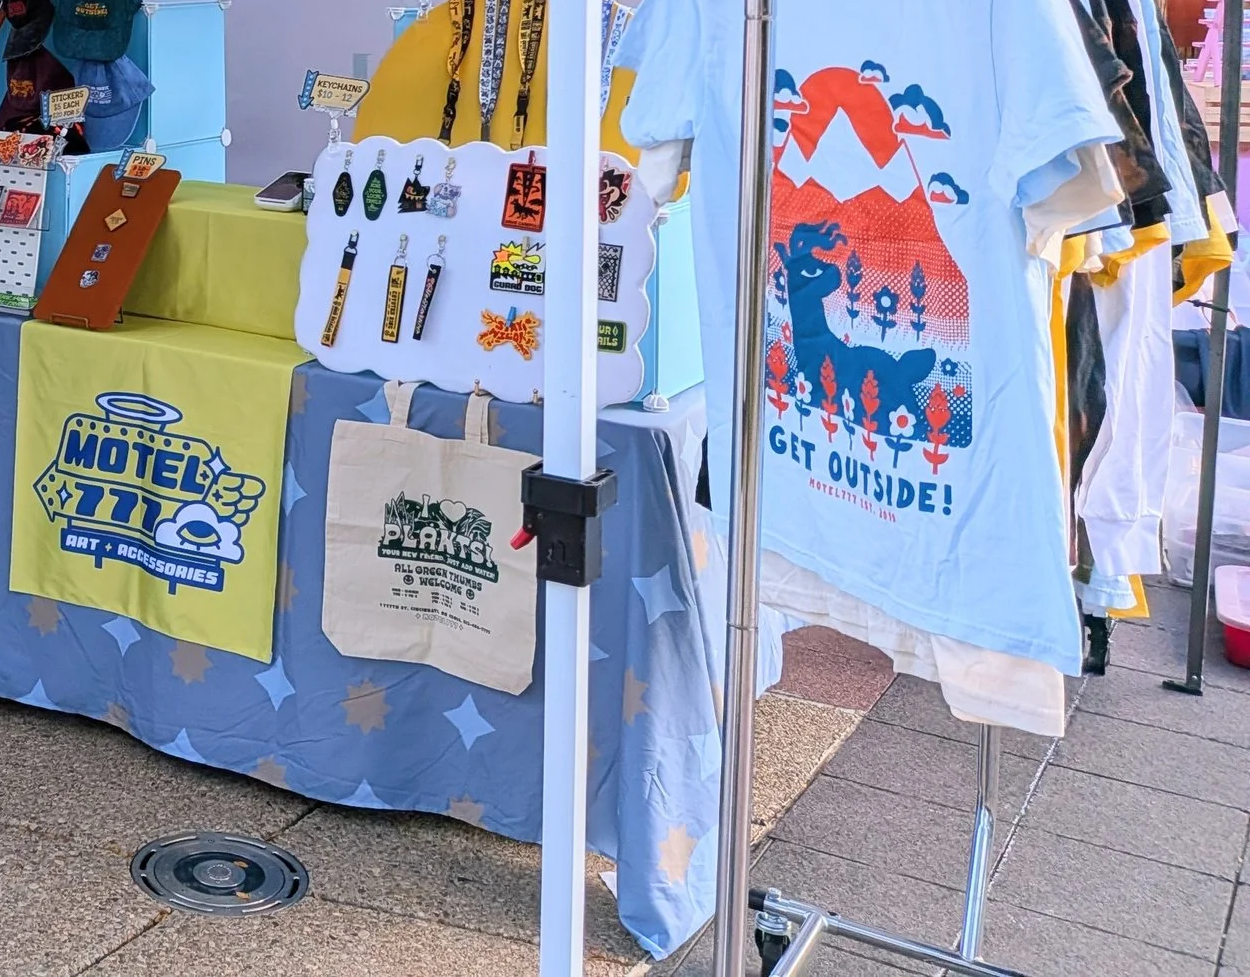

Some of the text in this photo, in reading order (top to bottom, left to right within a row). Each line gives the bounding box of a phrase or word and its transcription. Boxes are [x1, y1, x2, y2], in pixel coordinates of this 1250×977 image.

[51, 90, 84, 103] STICKERS
[317, 90, 352, 102] $10 12
[318, 80, 363, 94] KEYCHAINS
[53, 103, 61, 111] $5
[63, 100, 80, 110] EACH
[132, 155, 157, 166] PINS
[493, 280, 542, 293] GUARD DOG
[598, 336, 618, 346] AILS
[64, 429, 207, 495] MOTEL
[769, 425, 953, 516] GET OUTSIDE!
[809, 477, 858, 505] MOTEL777
[74, 482, 163, 531] 777
[422, 493, 430, 518] I
[383, 523, 493, 568] PLANTS!
[65, 534, 100, 551] ART
[117, 544, 219, 586] ACCESSORIES
[382, 548, 400, 556] YOUR
[461, 562, 473, 572] ADD
[395, 563, 482, 591] ALL GREEN THUMBS
[419, 577, 462, 596] WELCOME
